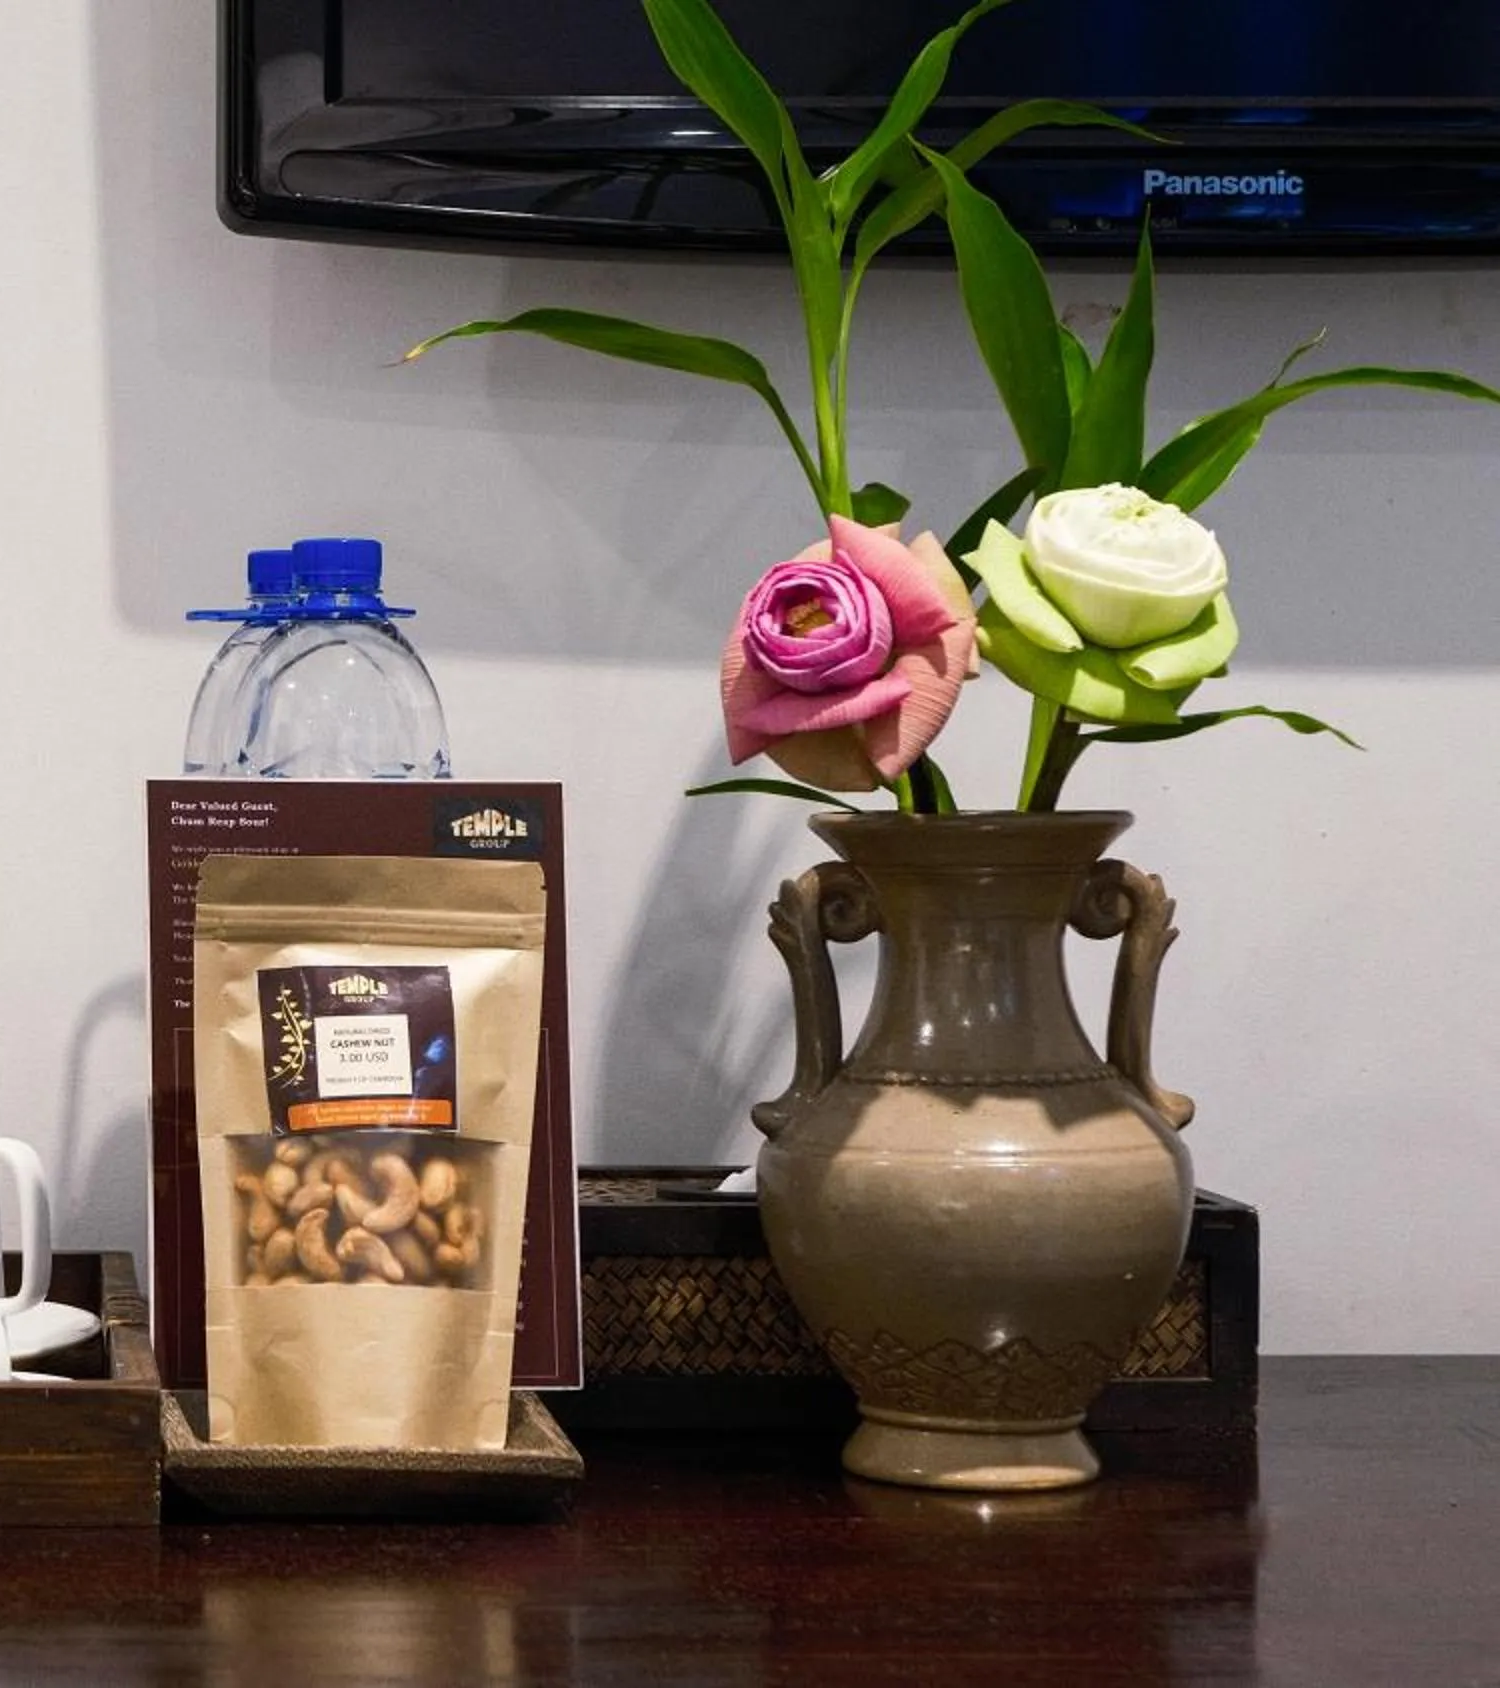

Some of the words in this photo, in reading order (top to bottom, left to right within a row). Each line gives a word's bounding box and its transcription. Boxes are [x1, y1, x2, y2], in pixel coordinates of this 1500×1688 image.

[1143, 169, 1304, 195] Panasonic
[171, 801, 197, 810] Dear
[200, 801, 238, 810] Valued
[450, 808, 528, 837] TEMPLE
[469, 839, 510, 848] GROUP
[328, 974, 389, 995] TEMPLE
[329, 1039, 372, 1049] CASHEW
[373, 1037, 396, 1048] NUT
[365, 1051, 389, 1063] USD
